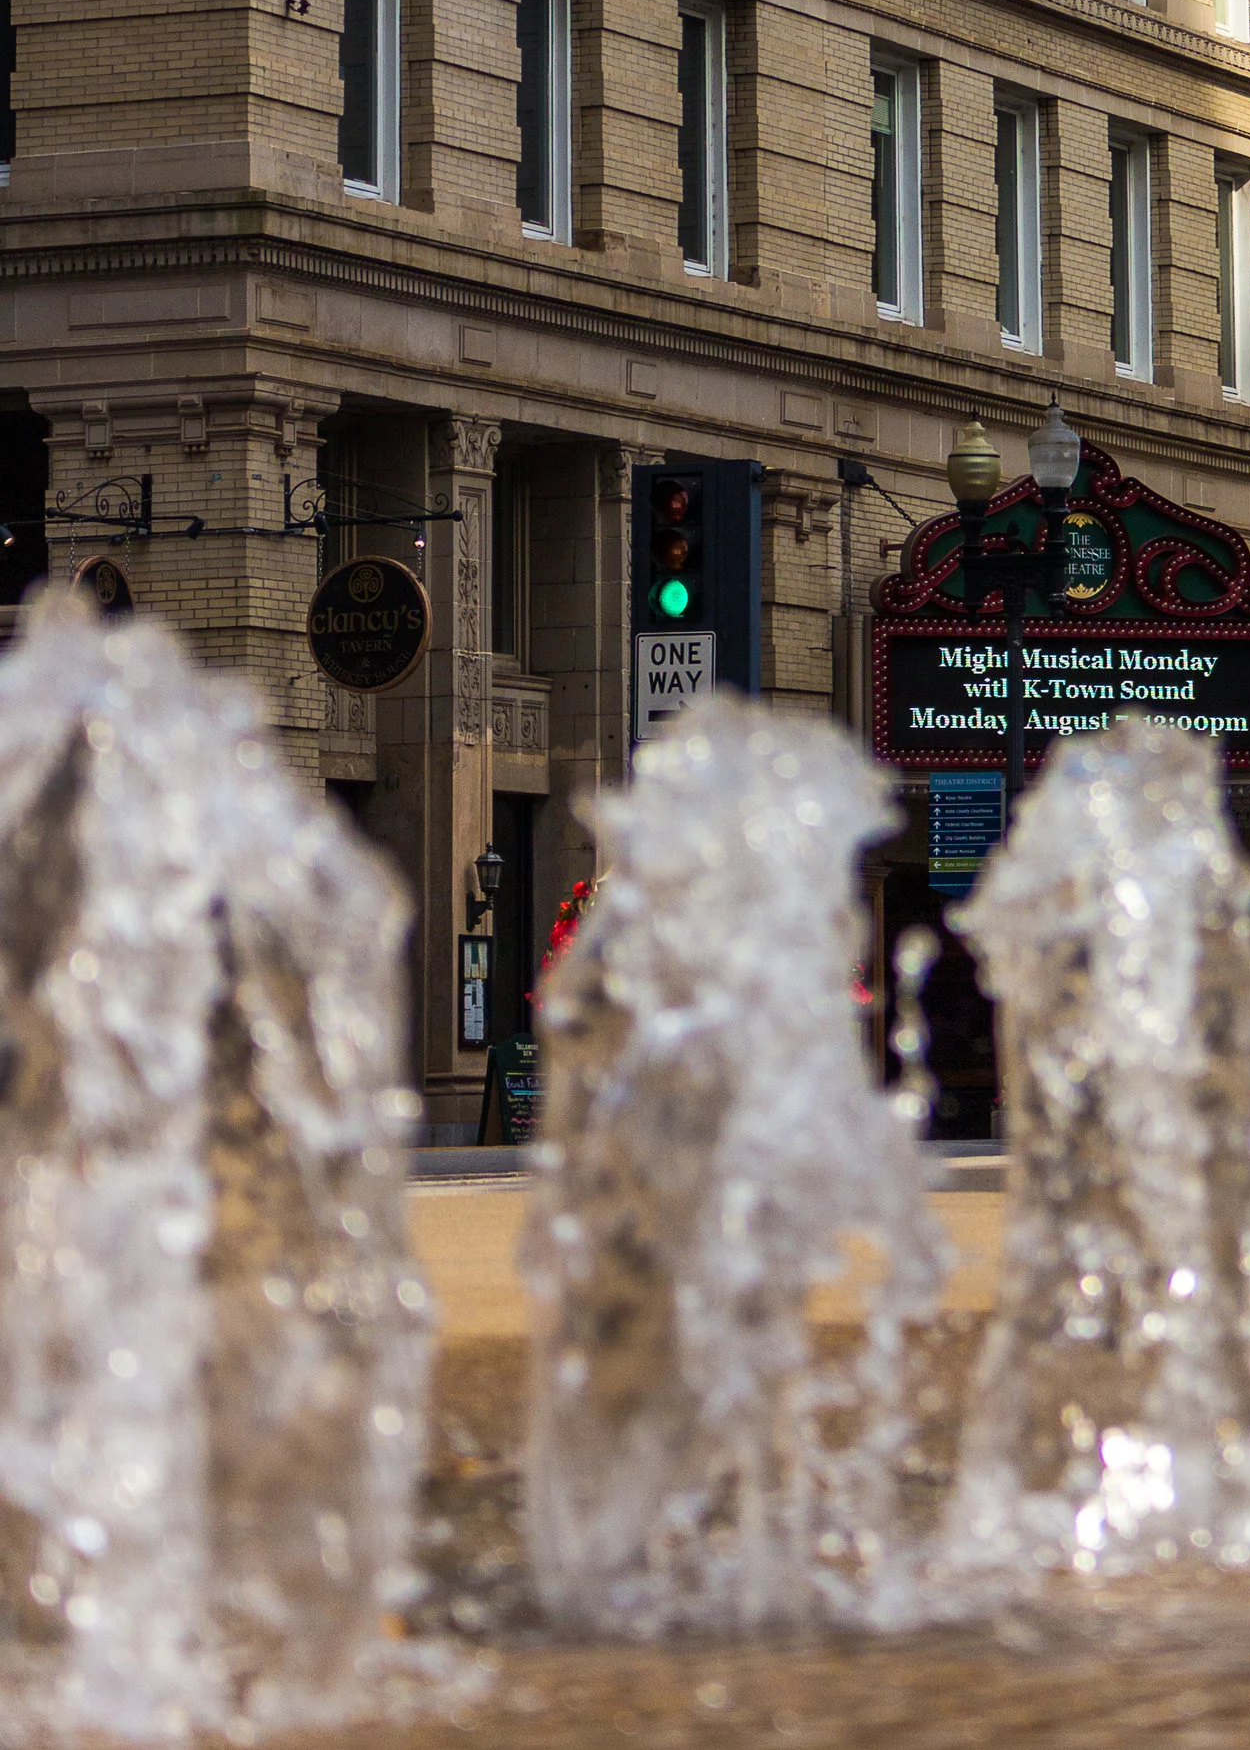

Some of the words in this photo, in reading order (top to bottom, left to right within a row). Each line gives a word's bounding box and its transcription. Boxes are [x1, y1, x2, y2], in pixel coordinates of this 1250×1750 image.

[1068, 531, 1091, 546] THE
[1064, 563, 1105, 576] HEATRE
[339, 639, 393, 654] TAVERN
[650, 642, 702, 666] ONE
[938, 646, 1009, 675] Might
[1022, 647, 1113, 670] Musical
[1118, 648, 1218, 677] Monday
[648, 670, 703, 695] WAY
[1022, 678, 1116, 699] K-Town
[1119, 680, 1195, 700] Sound
[909, 706, 1008, 735] Monday
[1023, 709, 1110, 736] August
[934, 778, 964, 786] THEATRE
[966, 777, 997, 785] DISTRICT
